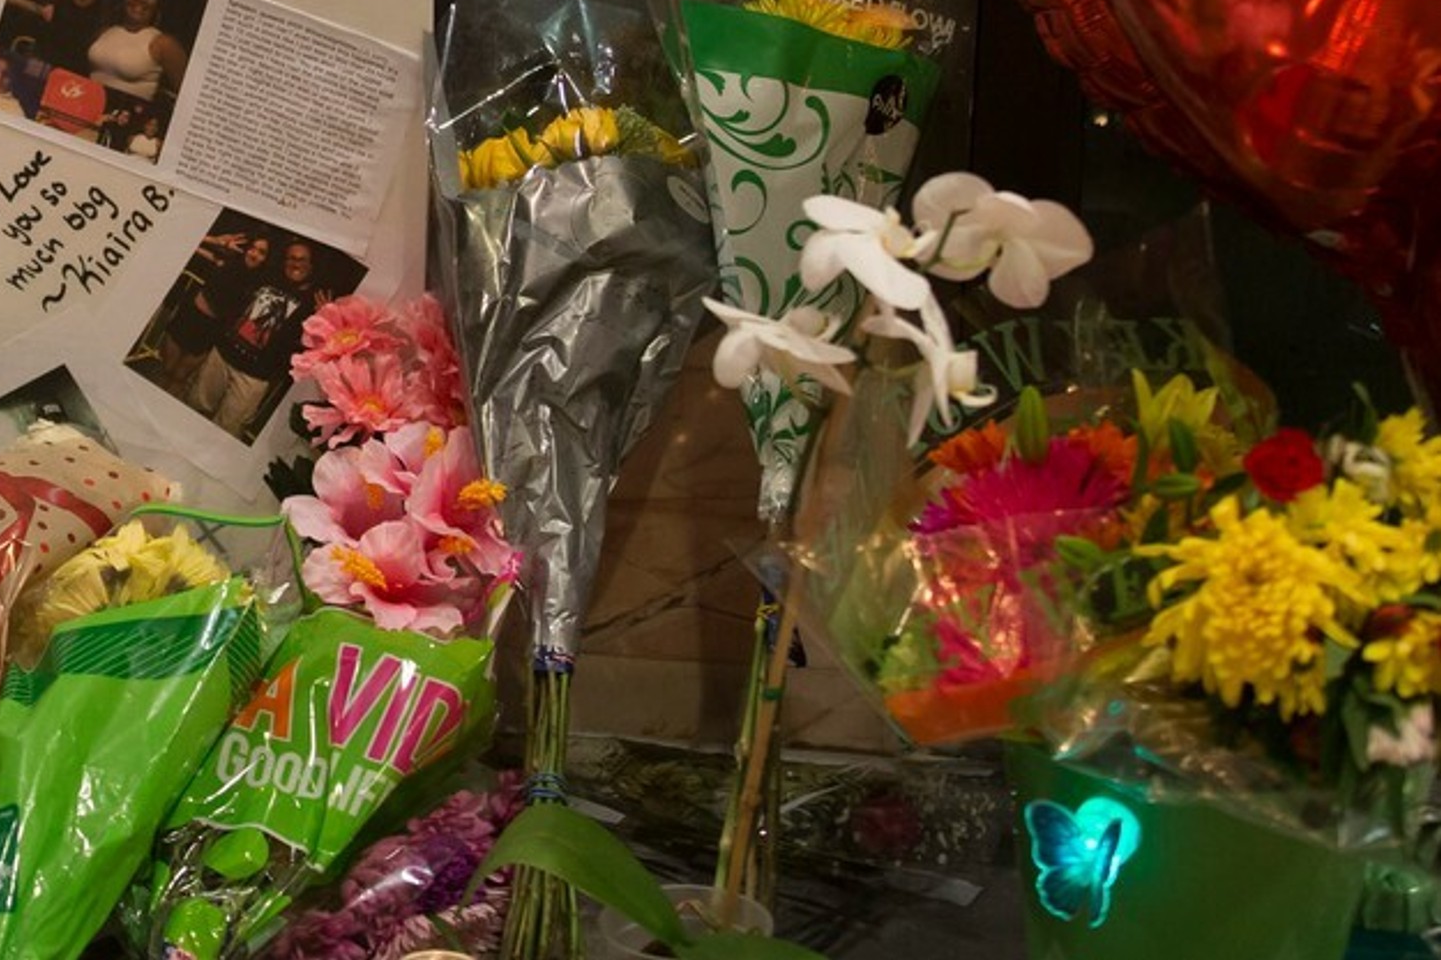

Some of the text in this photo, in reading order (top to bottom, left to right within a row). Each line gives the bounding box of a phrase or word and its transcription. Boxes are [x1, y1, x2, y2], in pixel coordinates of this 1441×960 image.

[2, 181, 68, 247] you so
[6, 238, 64, 291] much
[215, 731, 330, 800] GOOD
